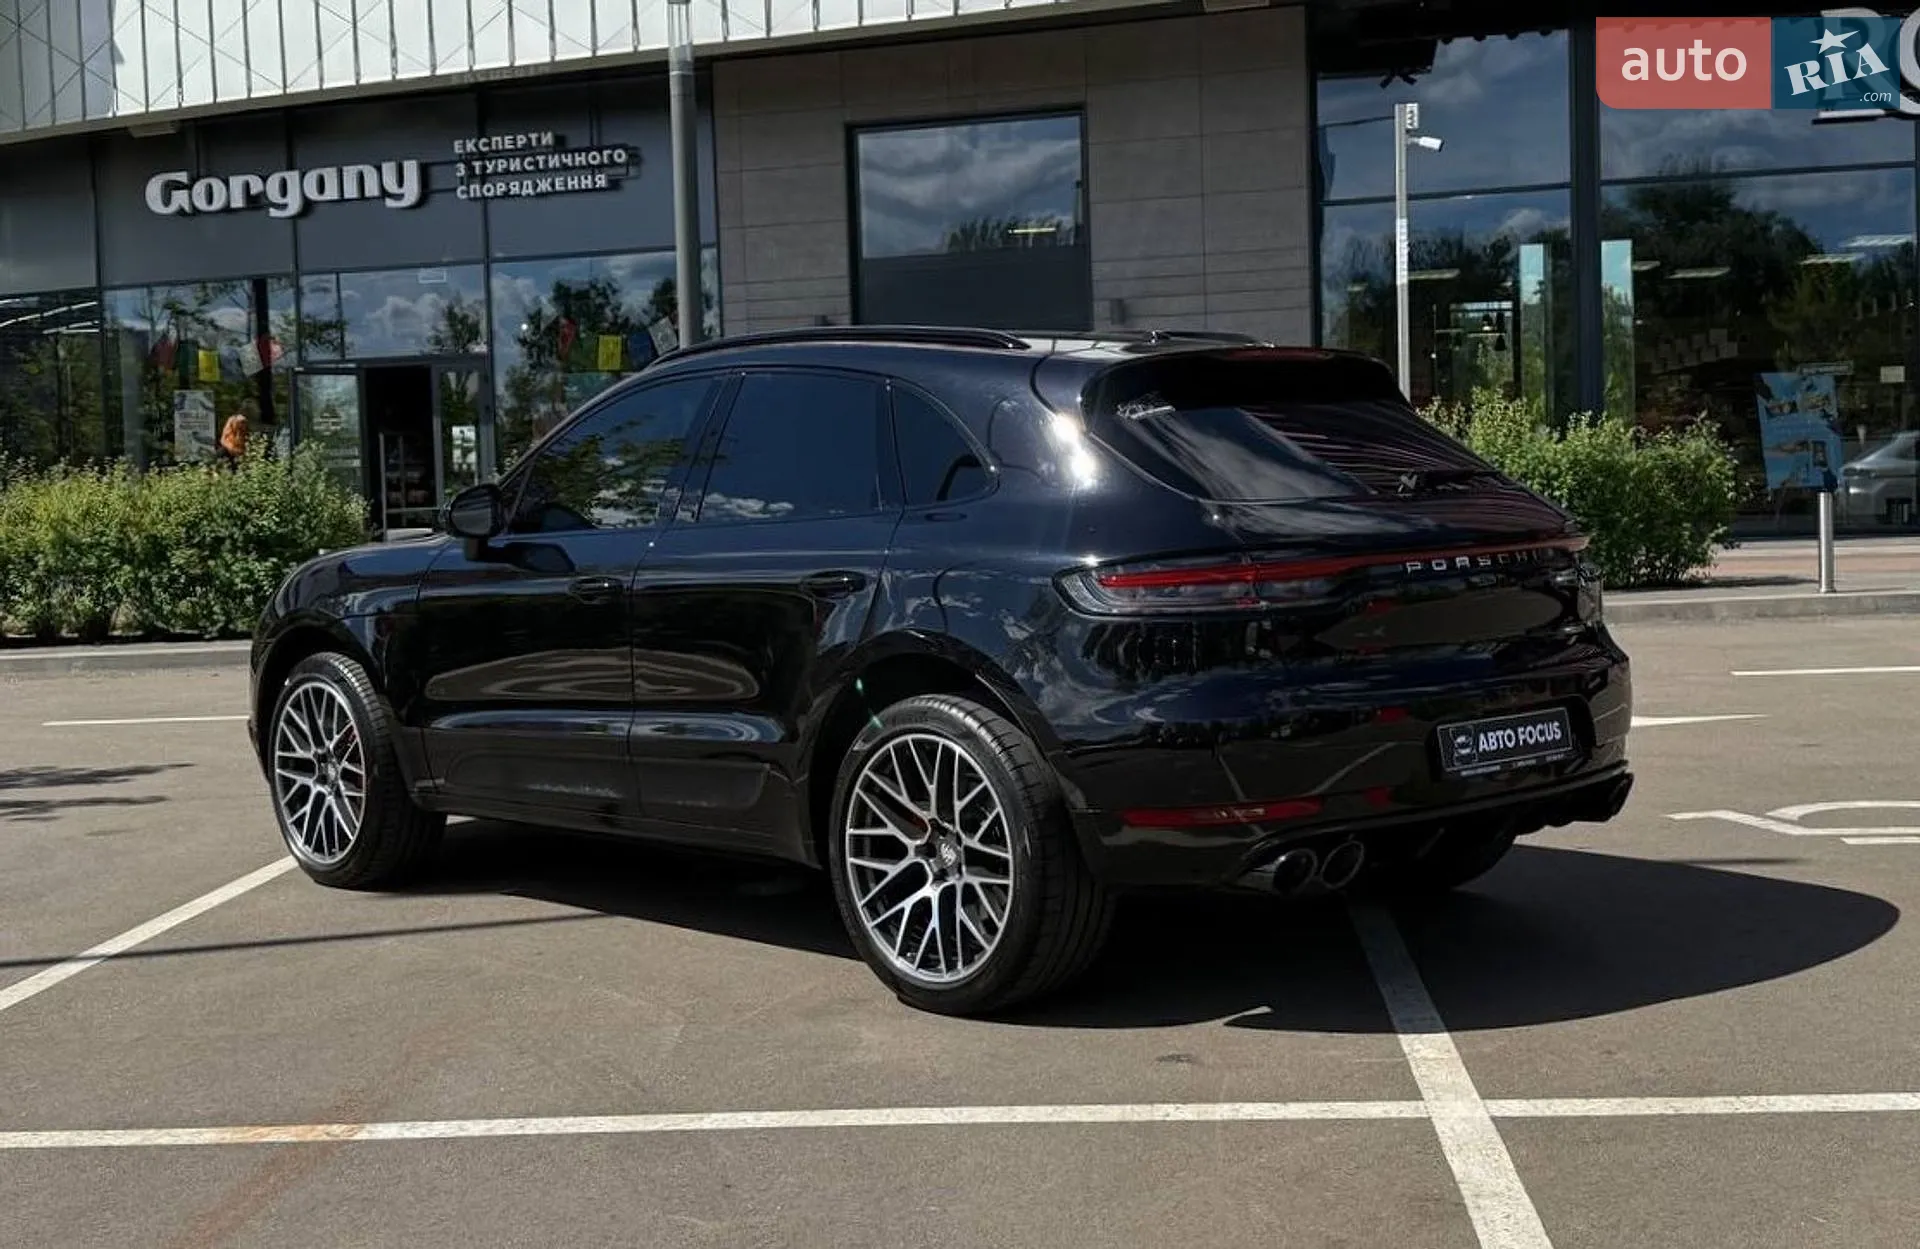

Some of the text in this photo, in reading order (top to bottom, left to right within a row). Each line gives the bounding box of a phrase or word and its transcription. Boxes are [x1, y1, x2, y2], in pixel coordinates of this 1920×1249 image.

[453, 131, 554, 154] ЕКСПЕРТИ
[472, 149, 627, 175] ТУРИСТИЧНОГО
[145, 159, 421, 218] Gorgany
[456, 174, 608, 199] СПОРЯДЖЕННЯ
[1517, 721, 1562, 746] FOCUS
